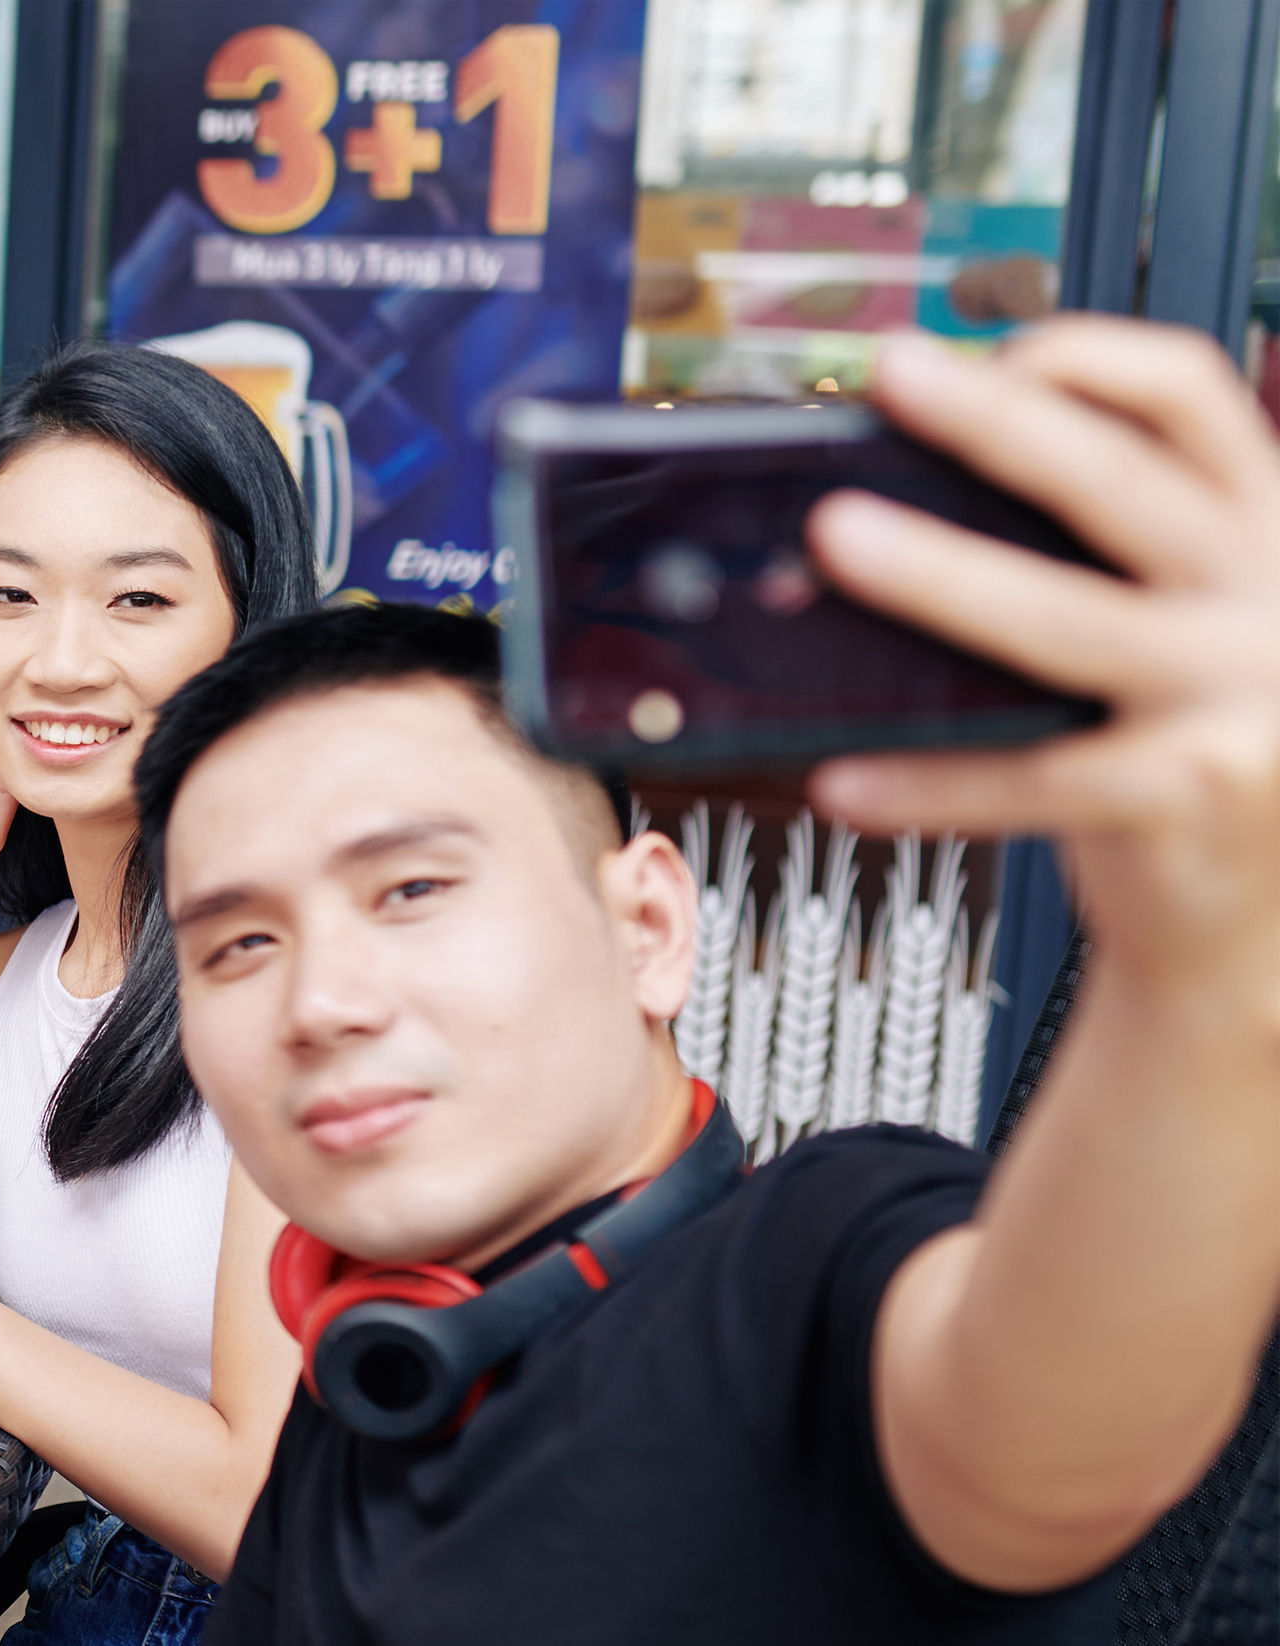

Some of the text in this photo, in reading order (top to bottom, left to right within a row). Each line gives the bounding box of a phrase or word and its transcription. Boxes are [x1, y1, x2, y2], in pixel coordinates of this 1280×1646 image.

[345, 60, 449, 103] FREE
[198, 108, 260, 143] BUY
[303, 243, 326, 281] 3
[387, 538, 491, 590] Enjoy
